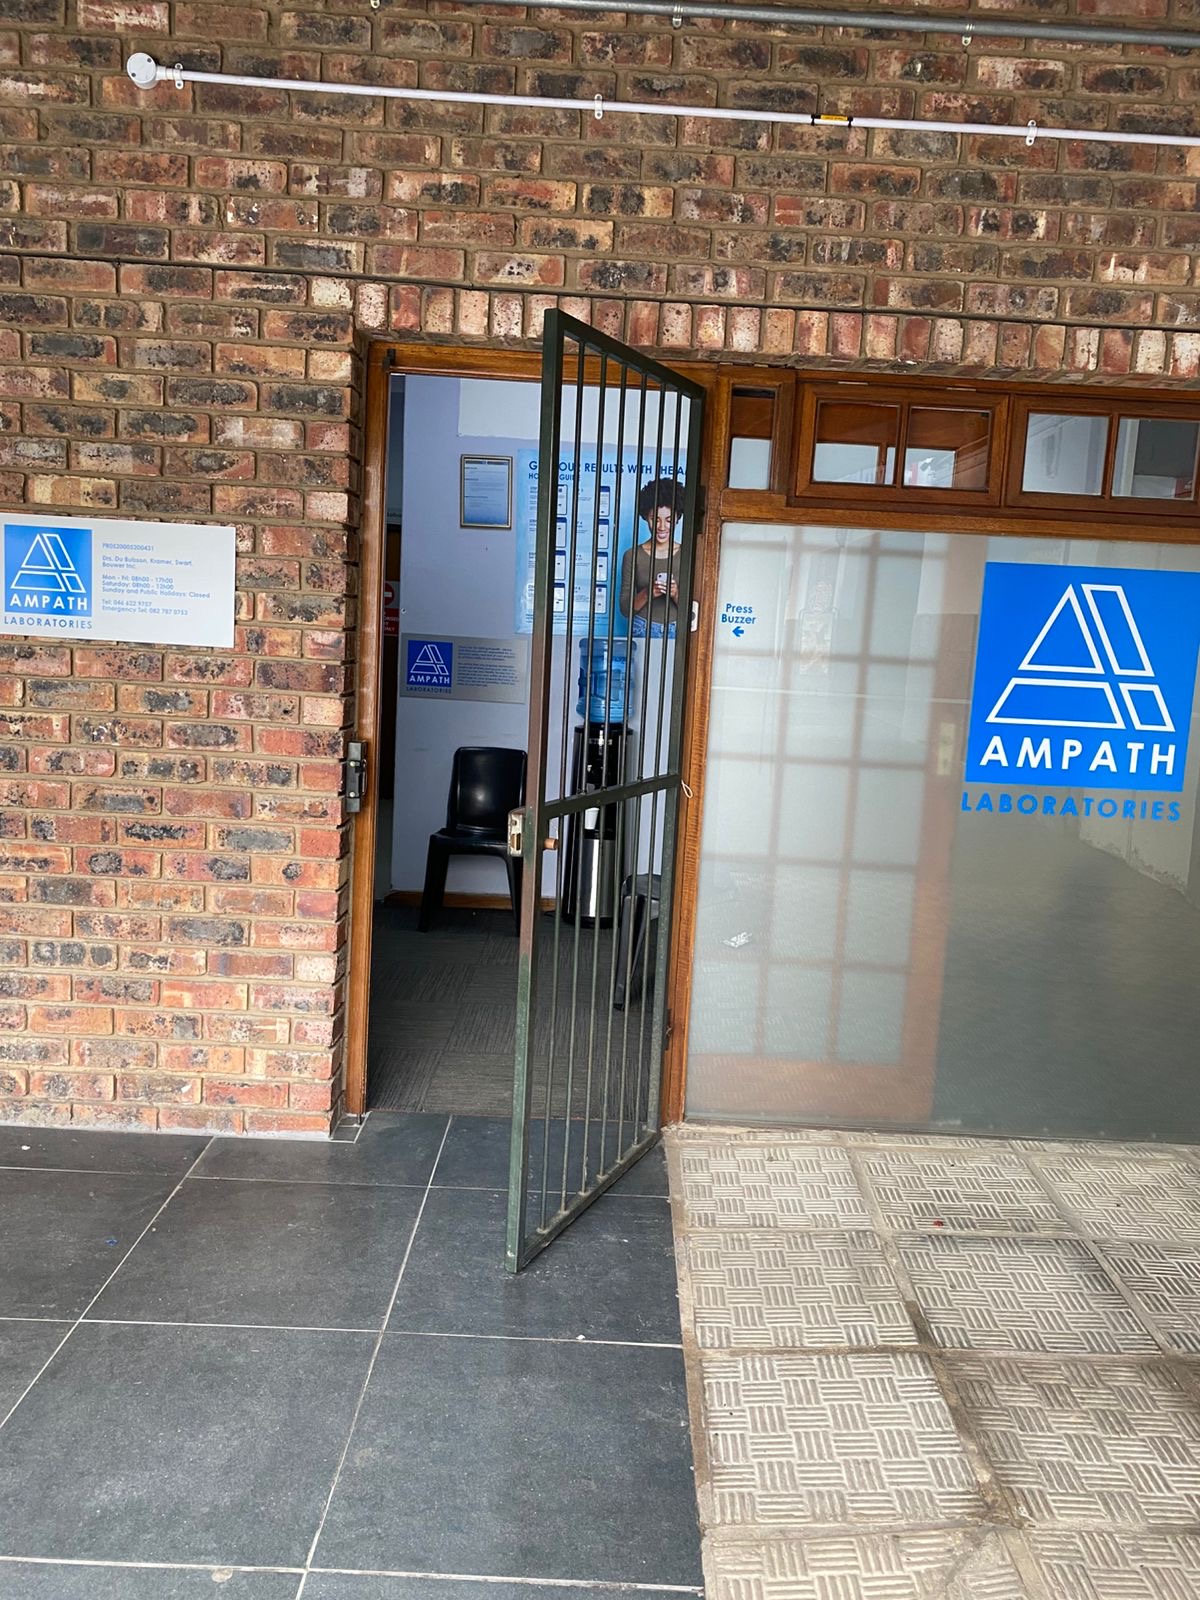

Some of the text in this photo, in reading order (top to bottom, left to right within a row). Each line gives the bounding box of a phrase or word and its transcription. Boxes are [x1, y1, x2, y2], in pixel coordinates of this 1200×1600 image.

[627, 464, 652, 475] WTH
[102, 586, 125, 594] Sunday
[188, 591, 210, 599] Closed
[9, 593, 88, 611] AMPATH
[102, 605, 137, 614] Emergency
[725, 603, 753, 614] Press
[4, 616, 92, 629] LABORATORIES
[721, 613, 756, 624] Buzzer
[409, 675, 450, 684] AMPATH
[979, 735, 1176, 775] AMPATH
[961, 791, 1181, 821] LABORATORIES
